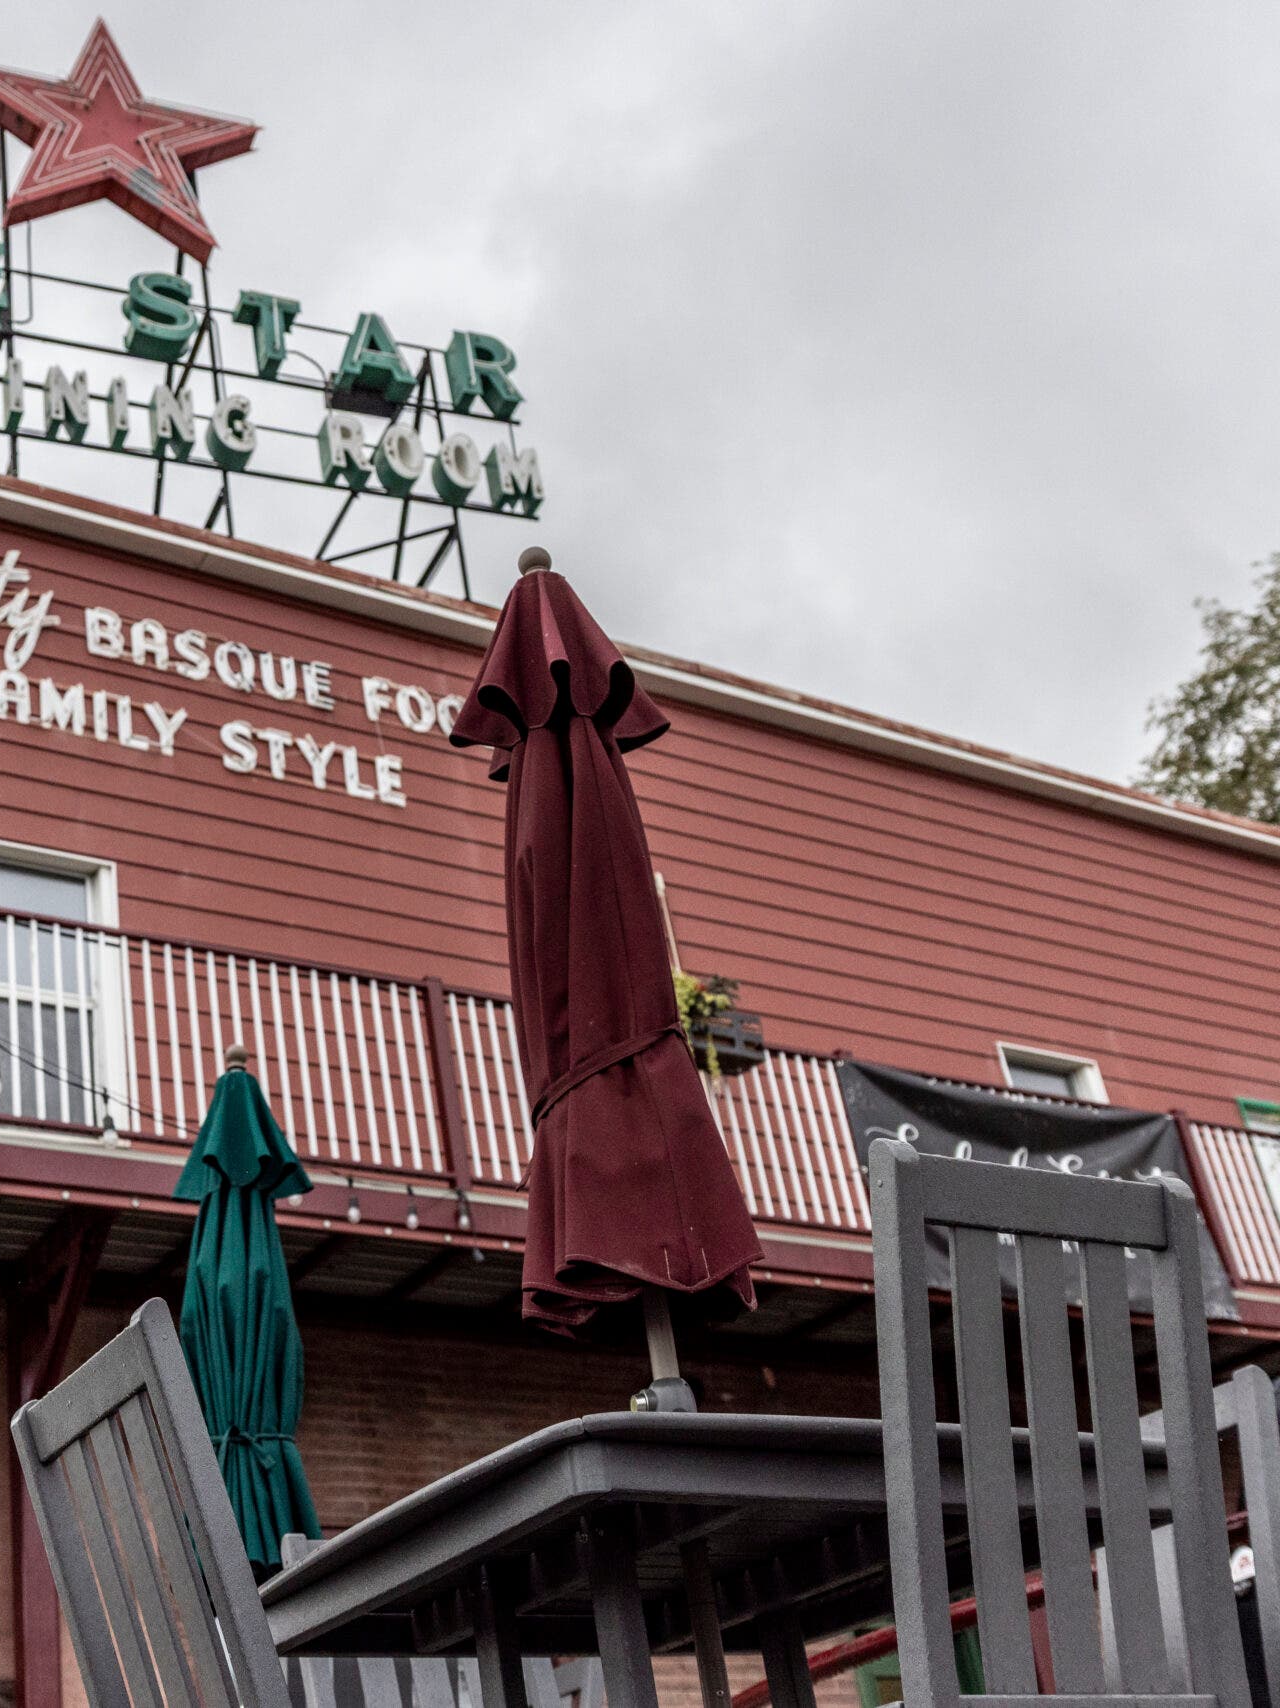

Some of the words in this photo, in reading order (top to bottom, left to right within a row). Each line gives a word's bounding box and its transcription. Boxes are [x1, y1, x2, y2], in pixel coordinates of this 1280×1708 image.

[122, 271, 524, 421] STAR
[320, 413, 544, 519] ROOM
[84, 606, 335, 712] BASQUE
[361, 675, 467, 739] FOO
[220, 719, 407, 809] STYLE
